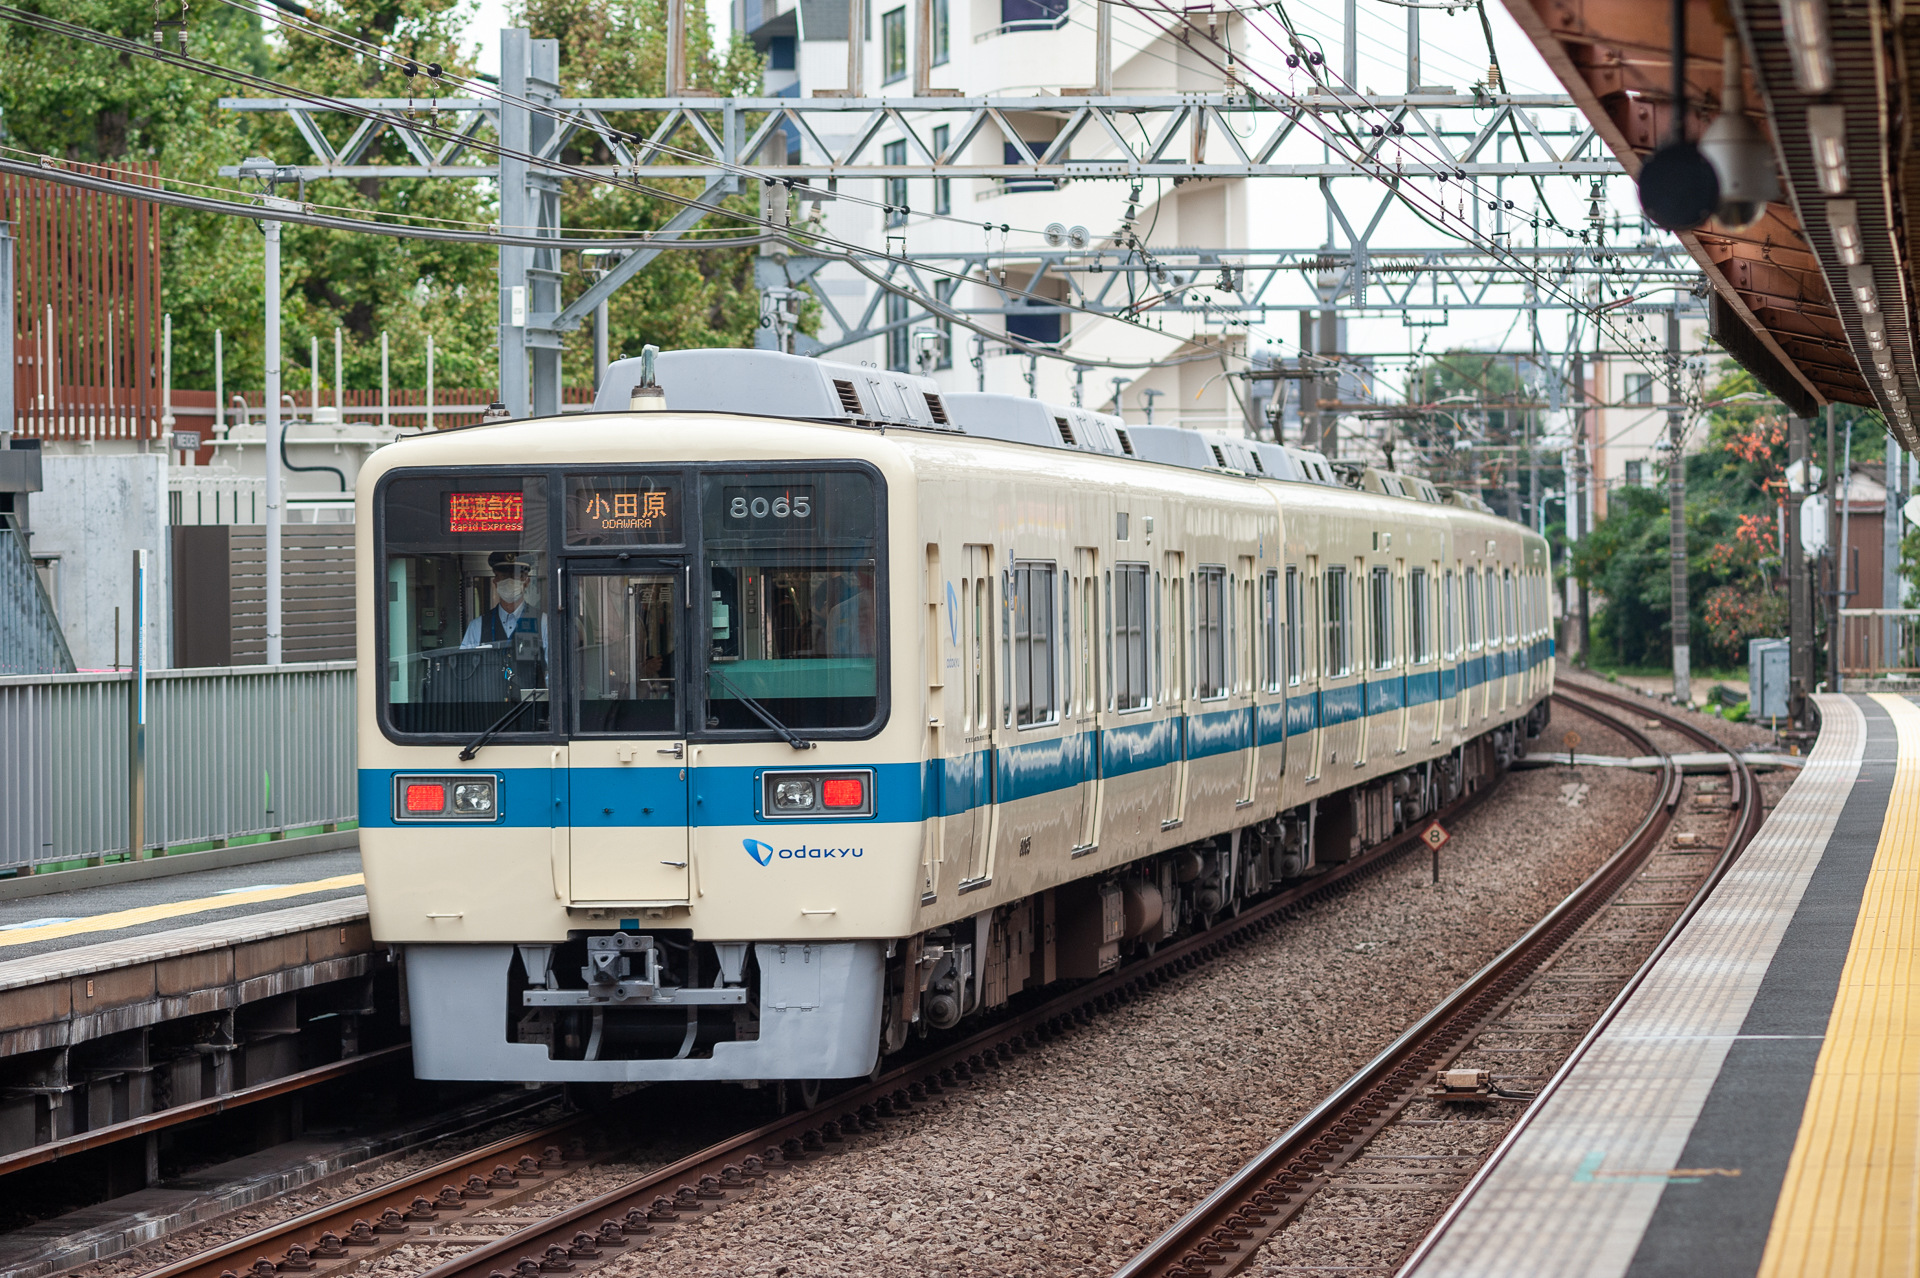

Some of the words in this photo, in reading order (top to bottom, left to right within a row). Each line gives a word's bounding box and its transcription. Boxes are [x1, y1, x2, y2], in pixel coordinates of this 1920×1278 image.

[450, 495, 523, 520] 快速急行
[585, 492, 667, 520] 小田原
[730, 496, 811, 518] 8065
[451, 521, 479, 531] Rapid
[481, 521, 523, 531] Express
[602, 518, 652, 529] ODAWARA
[1429, 829, 1440, 843] 8
[778, 845, 864, 859] odakyu
